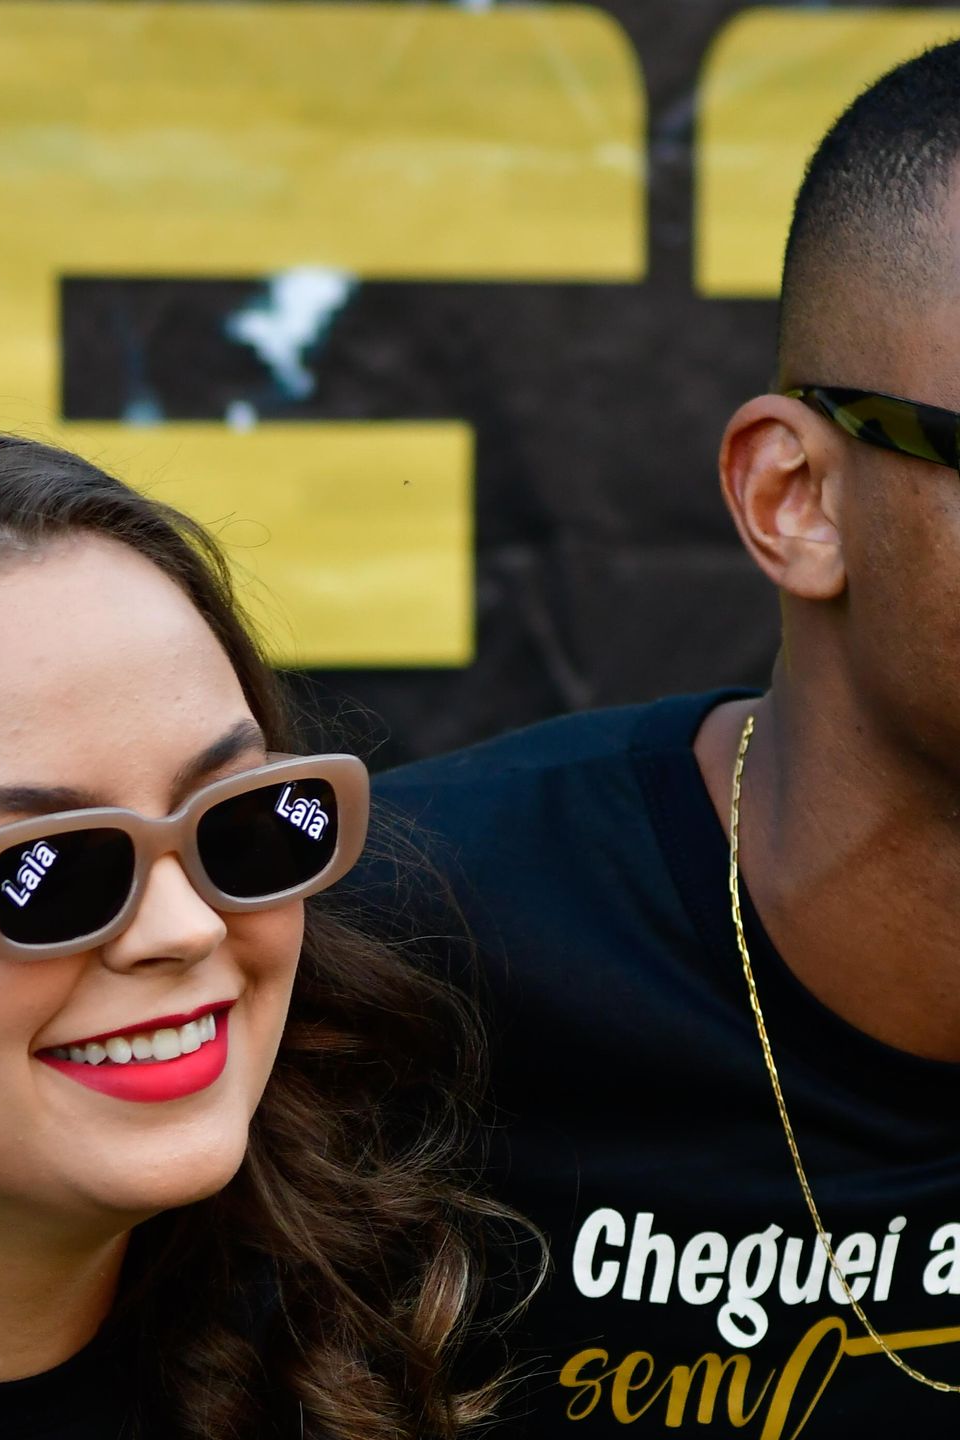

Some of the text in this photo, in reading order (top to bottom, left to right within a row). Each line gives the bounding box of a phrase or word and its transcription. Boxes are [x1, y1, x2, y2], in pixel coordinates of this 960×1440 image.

[275, 781, 329, 842] Lala
[2, 840, 58, 907] Lala
[572, 1208, 907, 1348] Cheguei
[559, 1348, 776, 1428] sem
